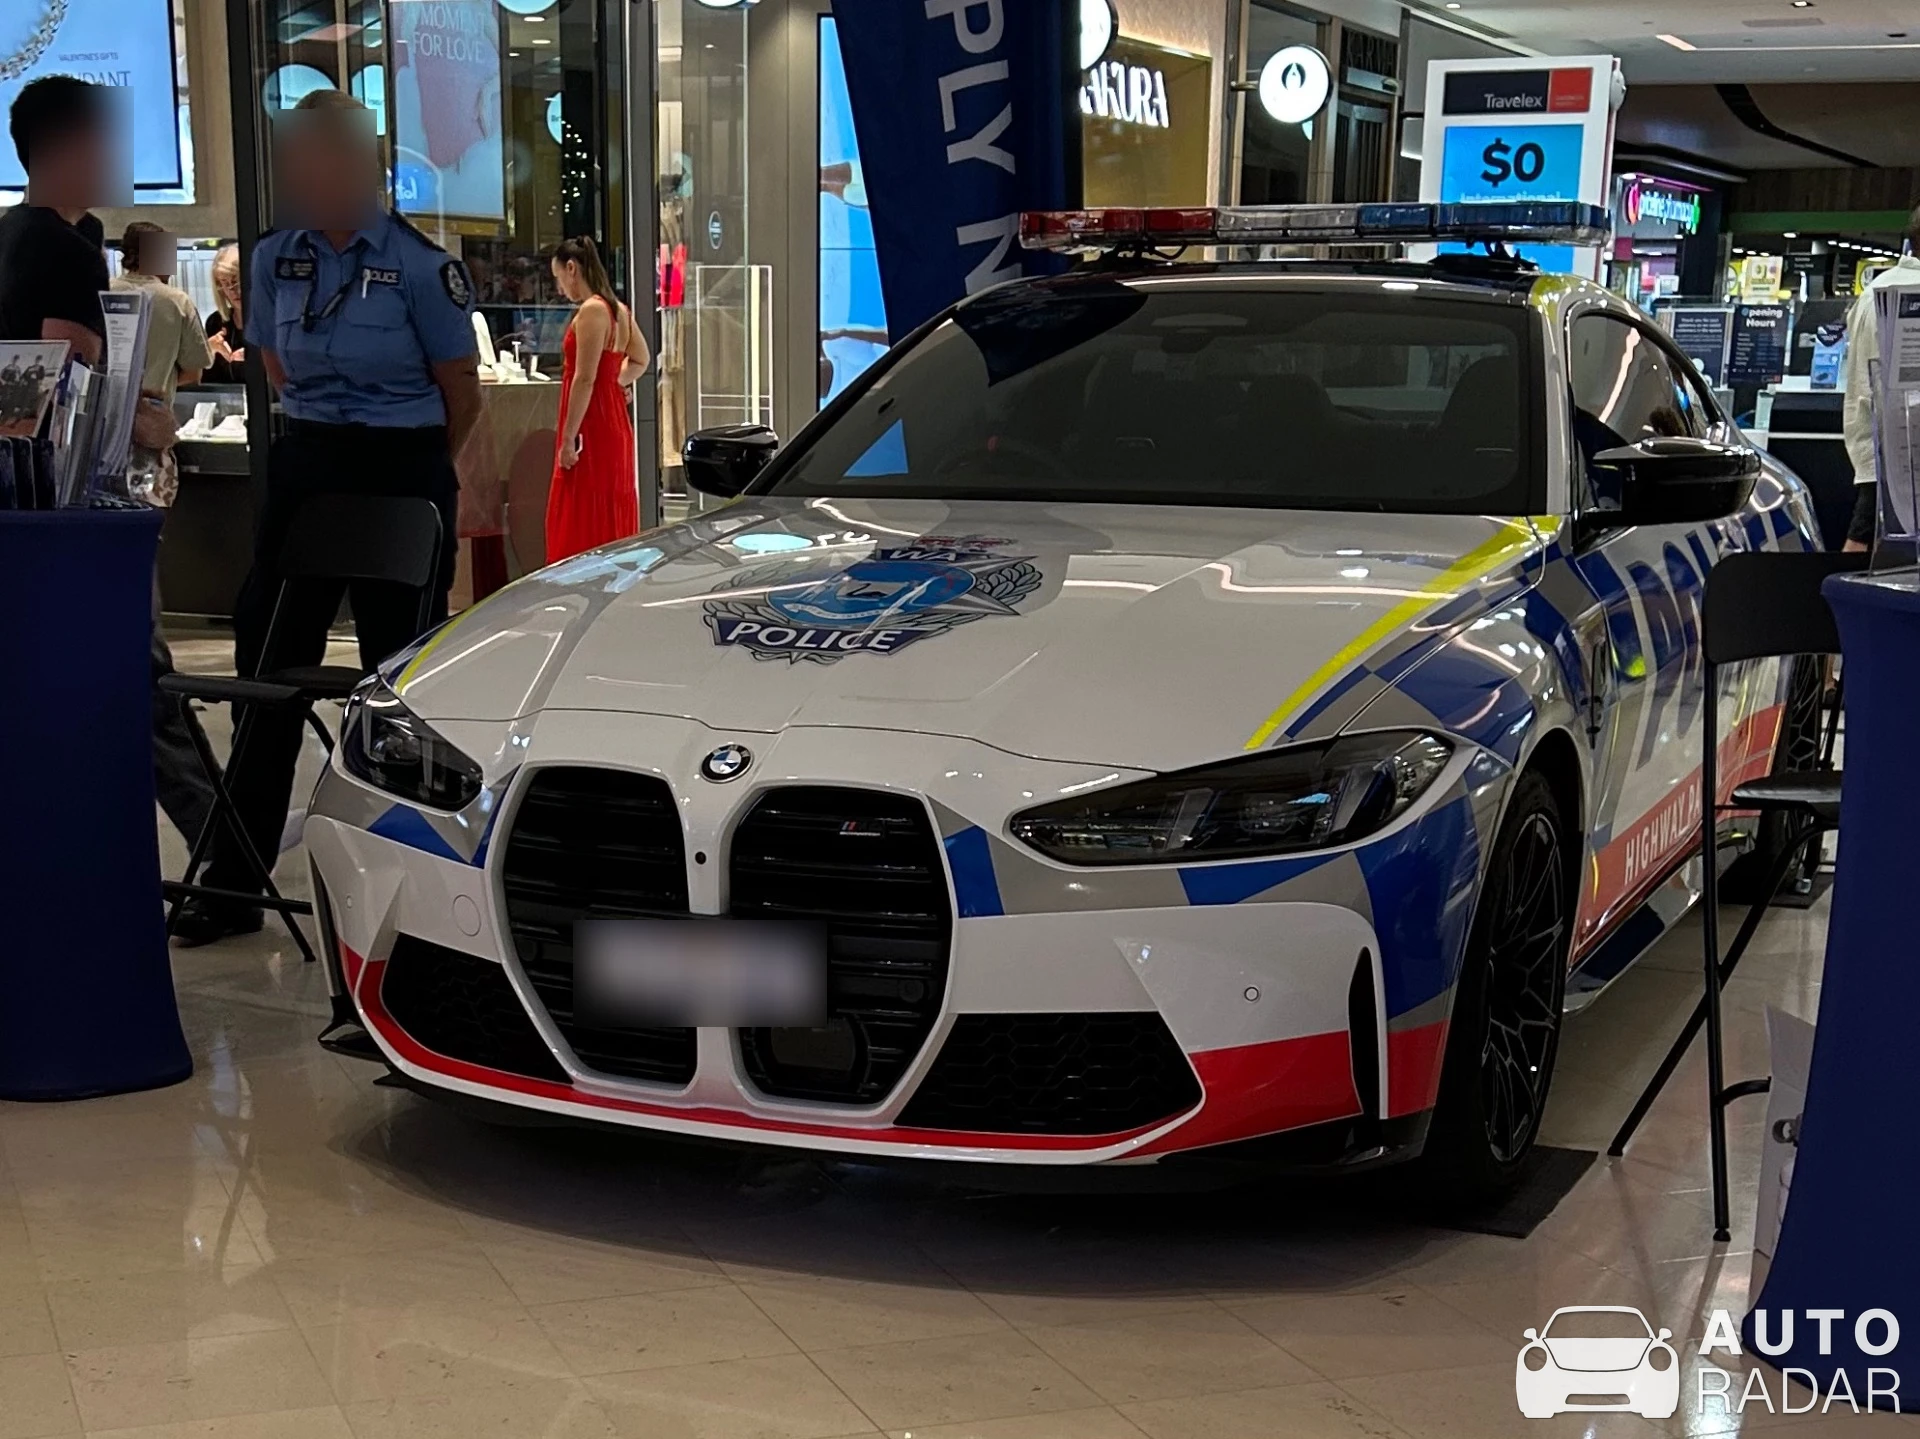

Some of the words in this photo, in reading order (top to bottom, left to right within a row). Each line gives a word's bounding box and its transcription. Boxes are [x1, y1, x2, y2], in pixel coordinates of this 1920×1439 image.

[413, 31, 442, 56] FOR
[446, 36, 484, 63] LOVE
[1079, 61, 1169, 128] AKURA
[1484, 93, 1543, 109] Travelex
[1480, 137, 1545, 188] $0
[889, 550, 957, 562] WA
[726, 622, 903, 651] POLICE
[1625, 791, 1688, 886] HIGHWAY
